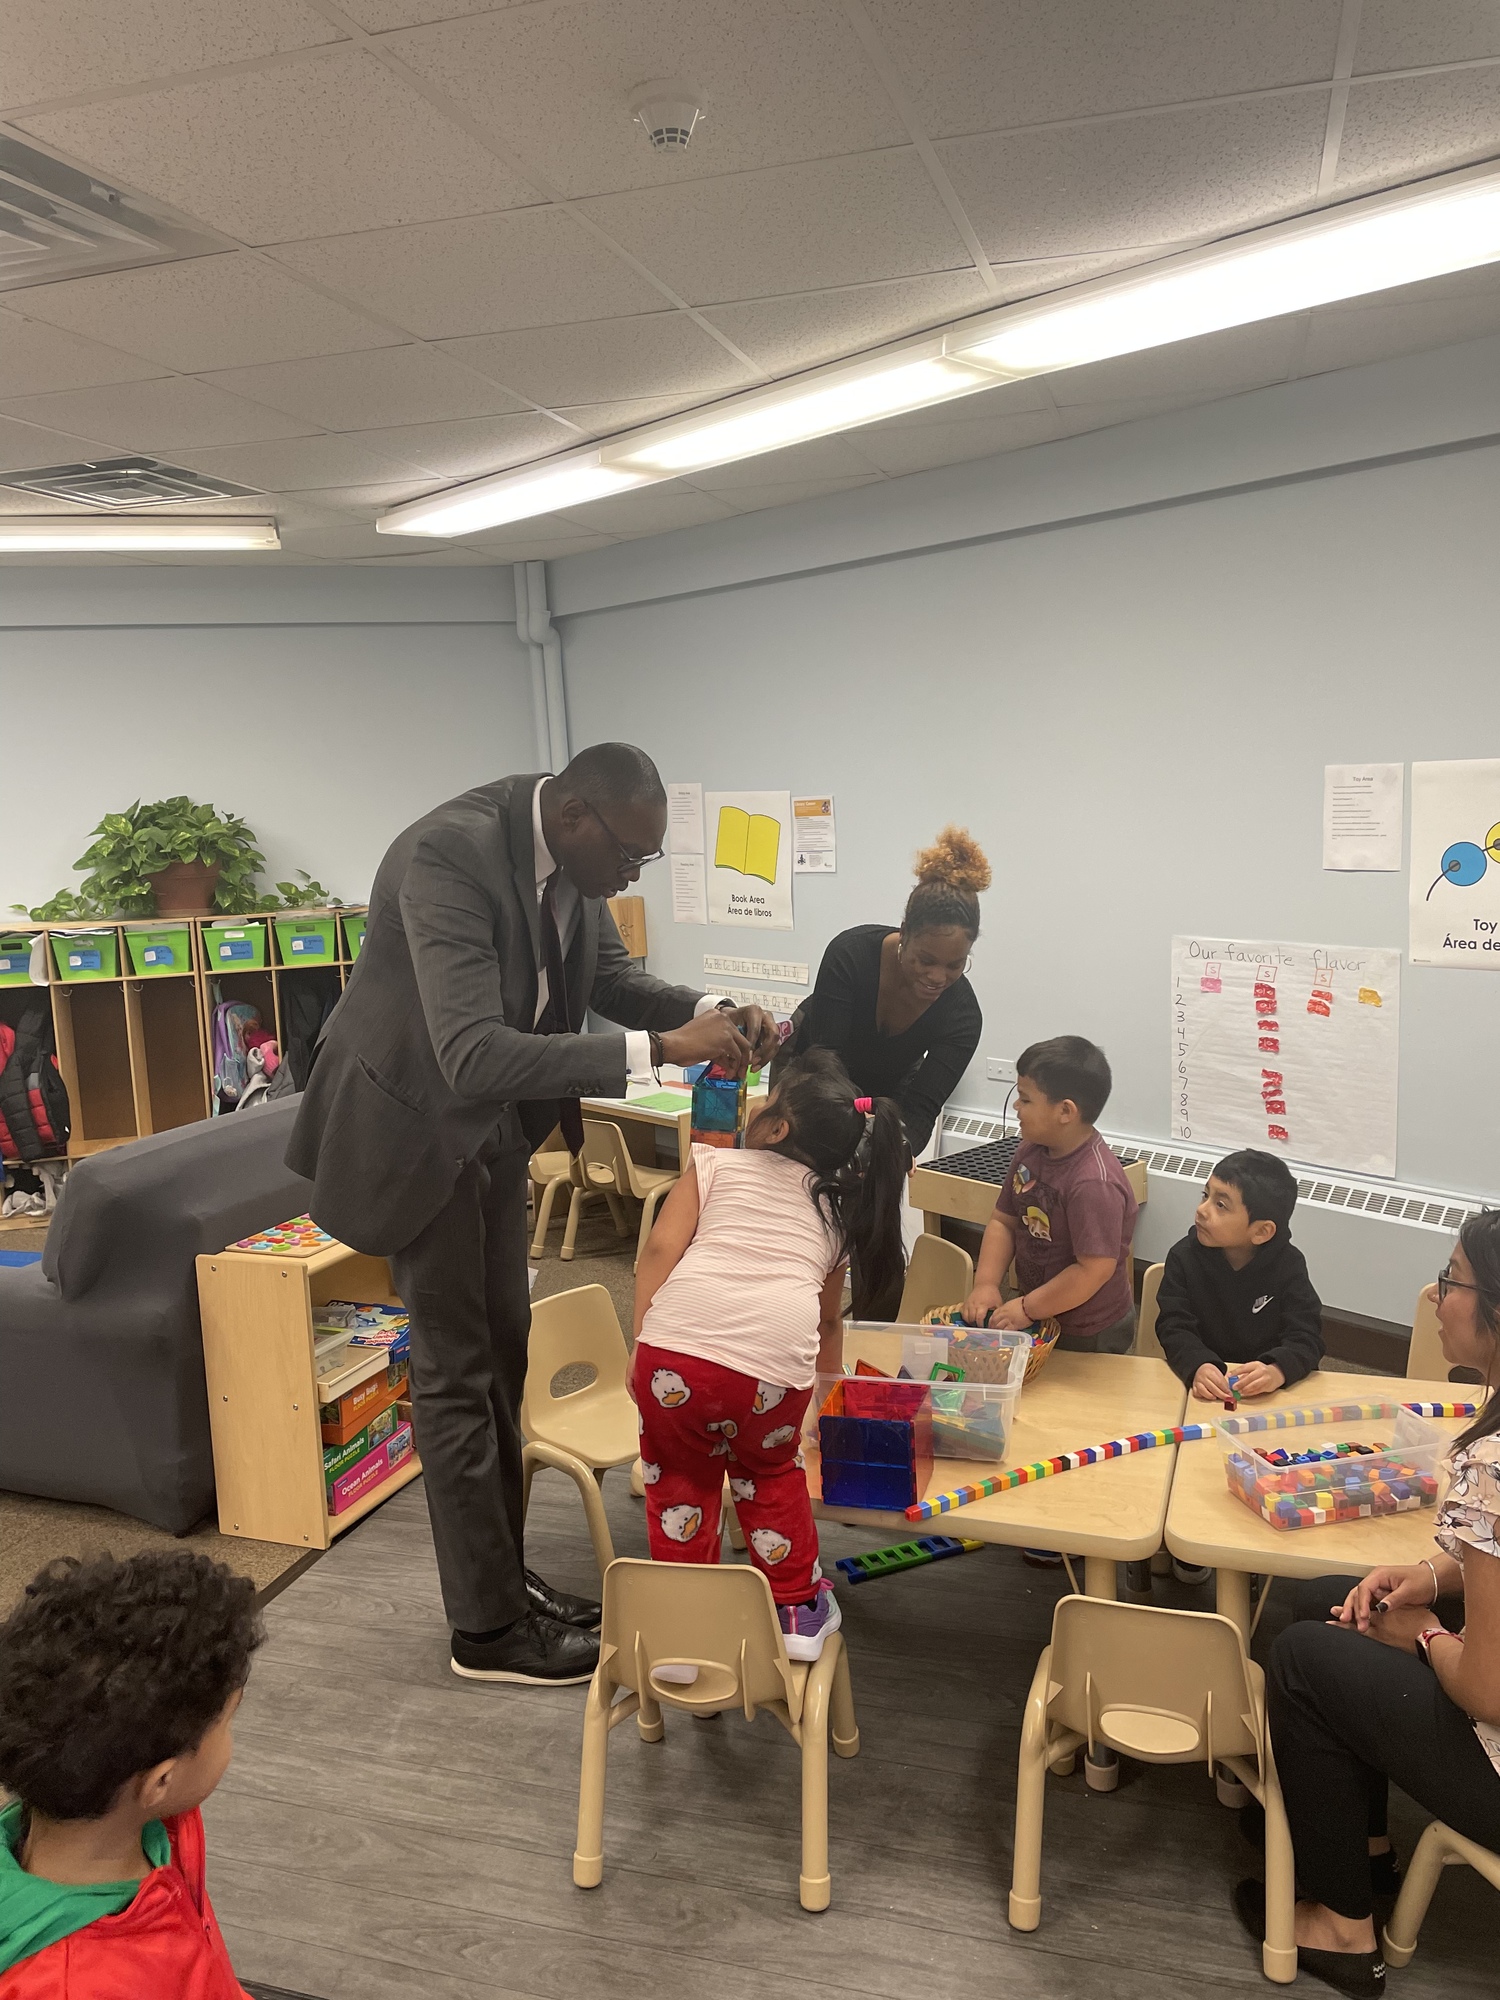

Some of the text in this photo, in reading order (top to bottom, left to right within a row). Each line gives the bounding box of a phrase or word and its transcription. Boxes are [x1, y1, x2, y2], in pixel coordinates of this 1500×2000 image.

[732, 894, 764, 904] Book Area
[727, 904, 772, 918] Área de libros
[1474, 919, 1498, 934] Toy
[1443, 933, 1500, 951] Área de
[1189, 940, 1366, 971] Our favorite flavor
[704, 958, 712, 969] Aa
[723, 959, 731, 971] Cc
[742, 962, 750, 973] Ee
[752, 963, 760, 974] Ff
[1175, 994, 1186, 1006] 2
[1177, 1011, 1185, 1022] 3
[1177, 1027, 1185, 1039] 4
[1178, 1043, 1189, 1056] 5
[1178, 1060, 1186, 1074] 6
[1178, 1076, 1188, 1090] 7
[1180, 1093, 1188, 1106] 8
[1180, 1108, 1189, 1122] 9
[1180, 1126, 1191, 1139] 10
[353, 1390, 365, 1405] Busy
[366, 1382, 378, 1396] Bugs
[324, 1437, 364, 1471] Safari Animals
[329, 1460, 344, 1474] FLOOR
[344, 1448, 361, 1462] PUZZLE
[341, 1476, 361, 1496] Ocean
[361, 1458, 383, 1478] Animals
[348, 1483, 364, 1498] FLOOR
[363, 1470, 379, 1486] PUZZLE
